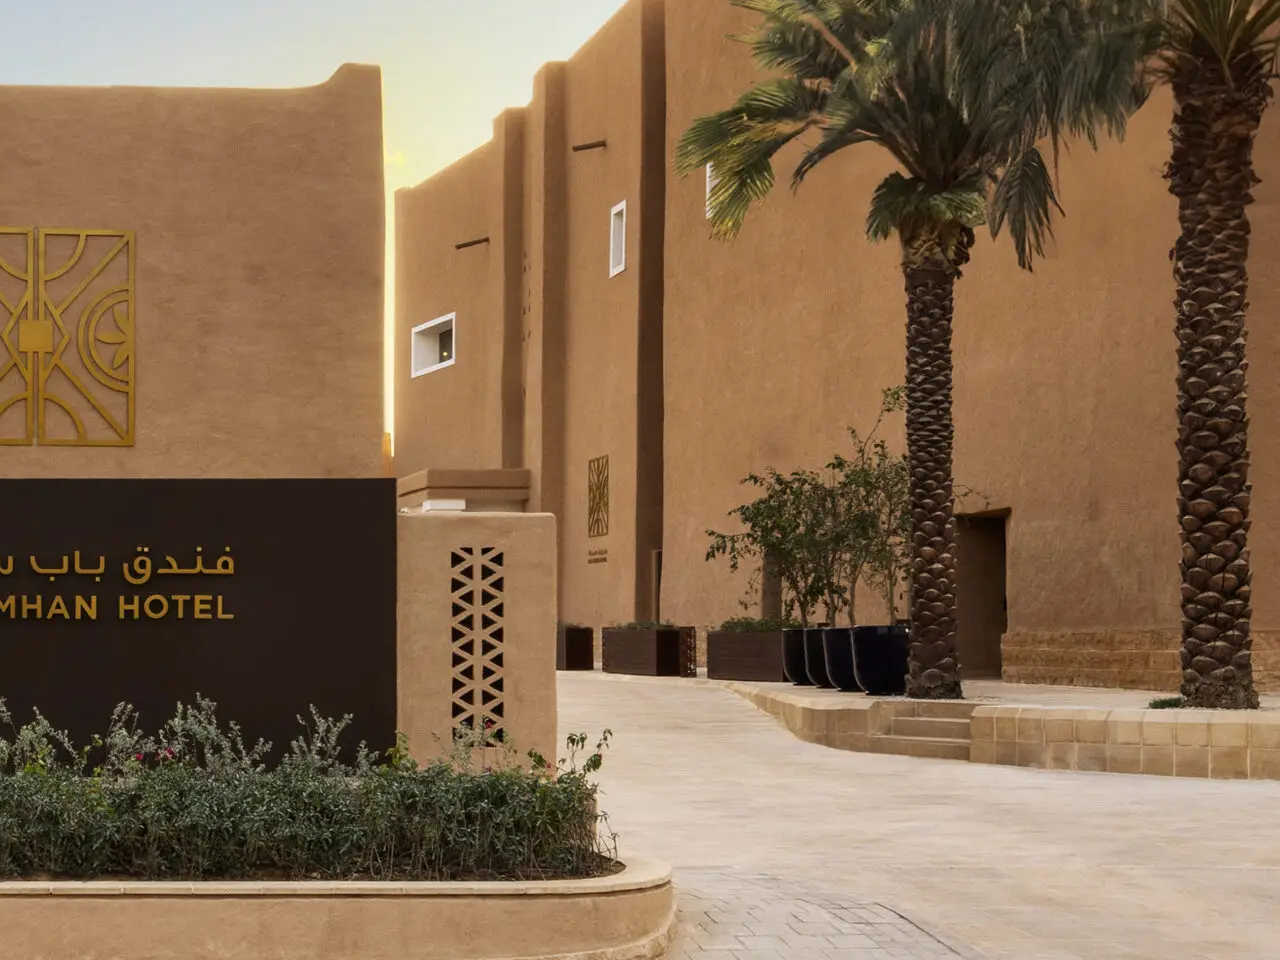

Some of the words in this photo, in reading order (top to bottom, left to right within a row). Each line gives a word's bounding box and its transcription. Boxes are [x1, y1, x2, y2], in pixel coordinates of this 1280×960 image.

[29, 550, 105, 582] باب
[122, 545, 235, 585] فندق
[119, 594, 235, 620] HOTEL
